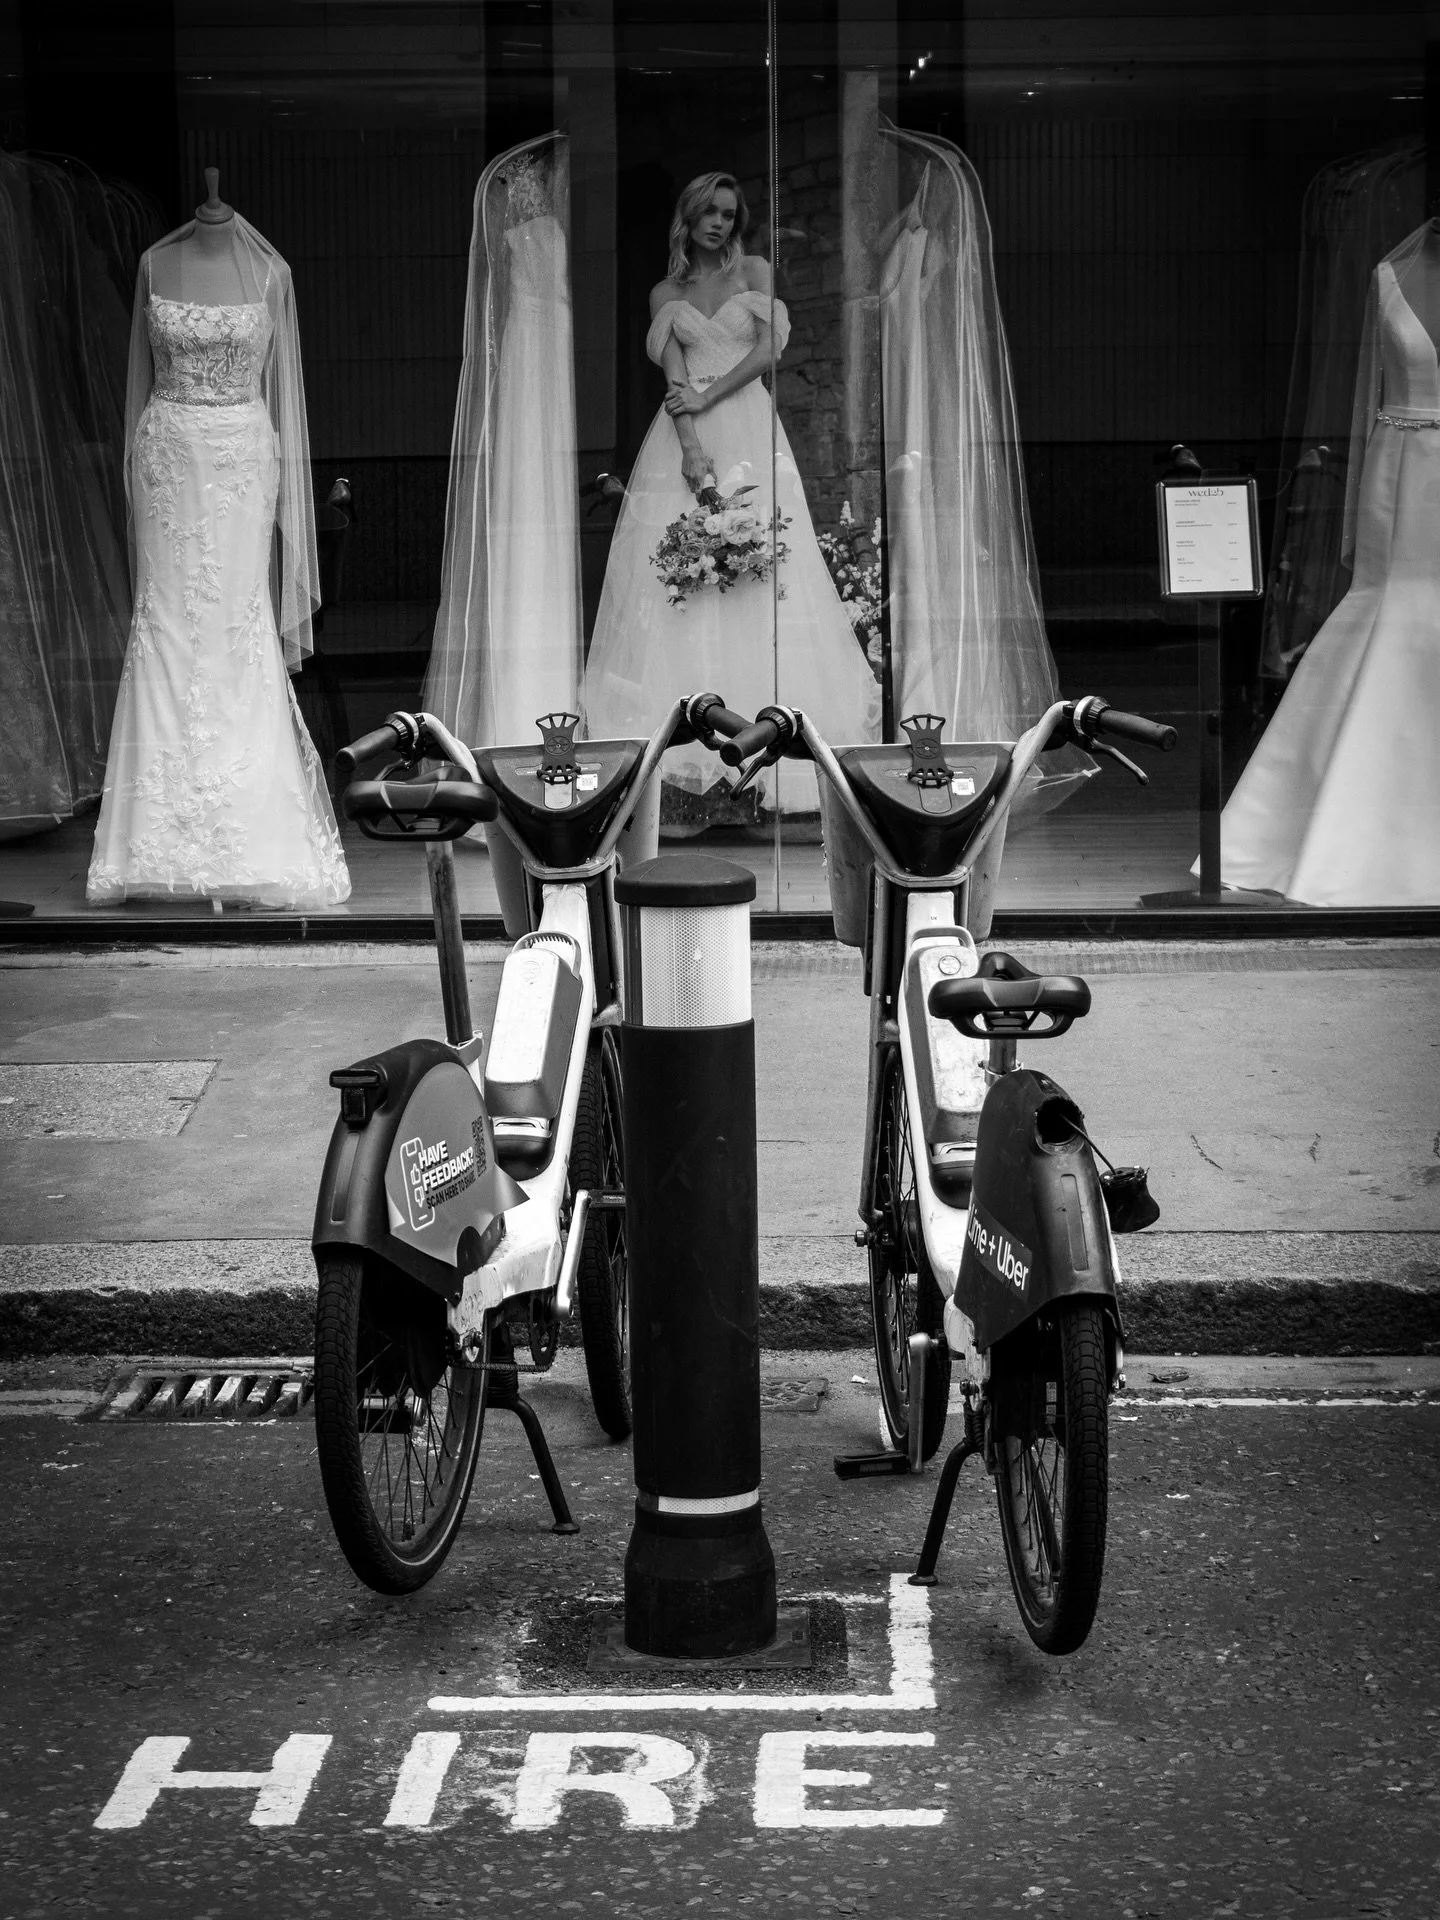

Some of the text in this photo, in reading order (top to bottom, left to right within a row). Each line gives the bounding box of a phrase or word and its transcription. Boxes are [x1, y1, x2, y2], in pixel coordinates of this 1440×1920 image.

[418, 1140, 448, 1169] HAVE
[421, 1146, 474, 1192] FEEDBACK?
[426, 1191, 445, 1209] SCAN
[444, 1183, 459, 1201] HERE
[997, 1236, 1029, 1291] Uber
[93, 1731, 946, 1829] HIRE
